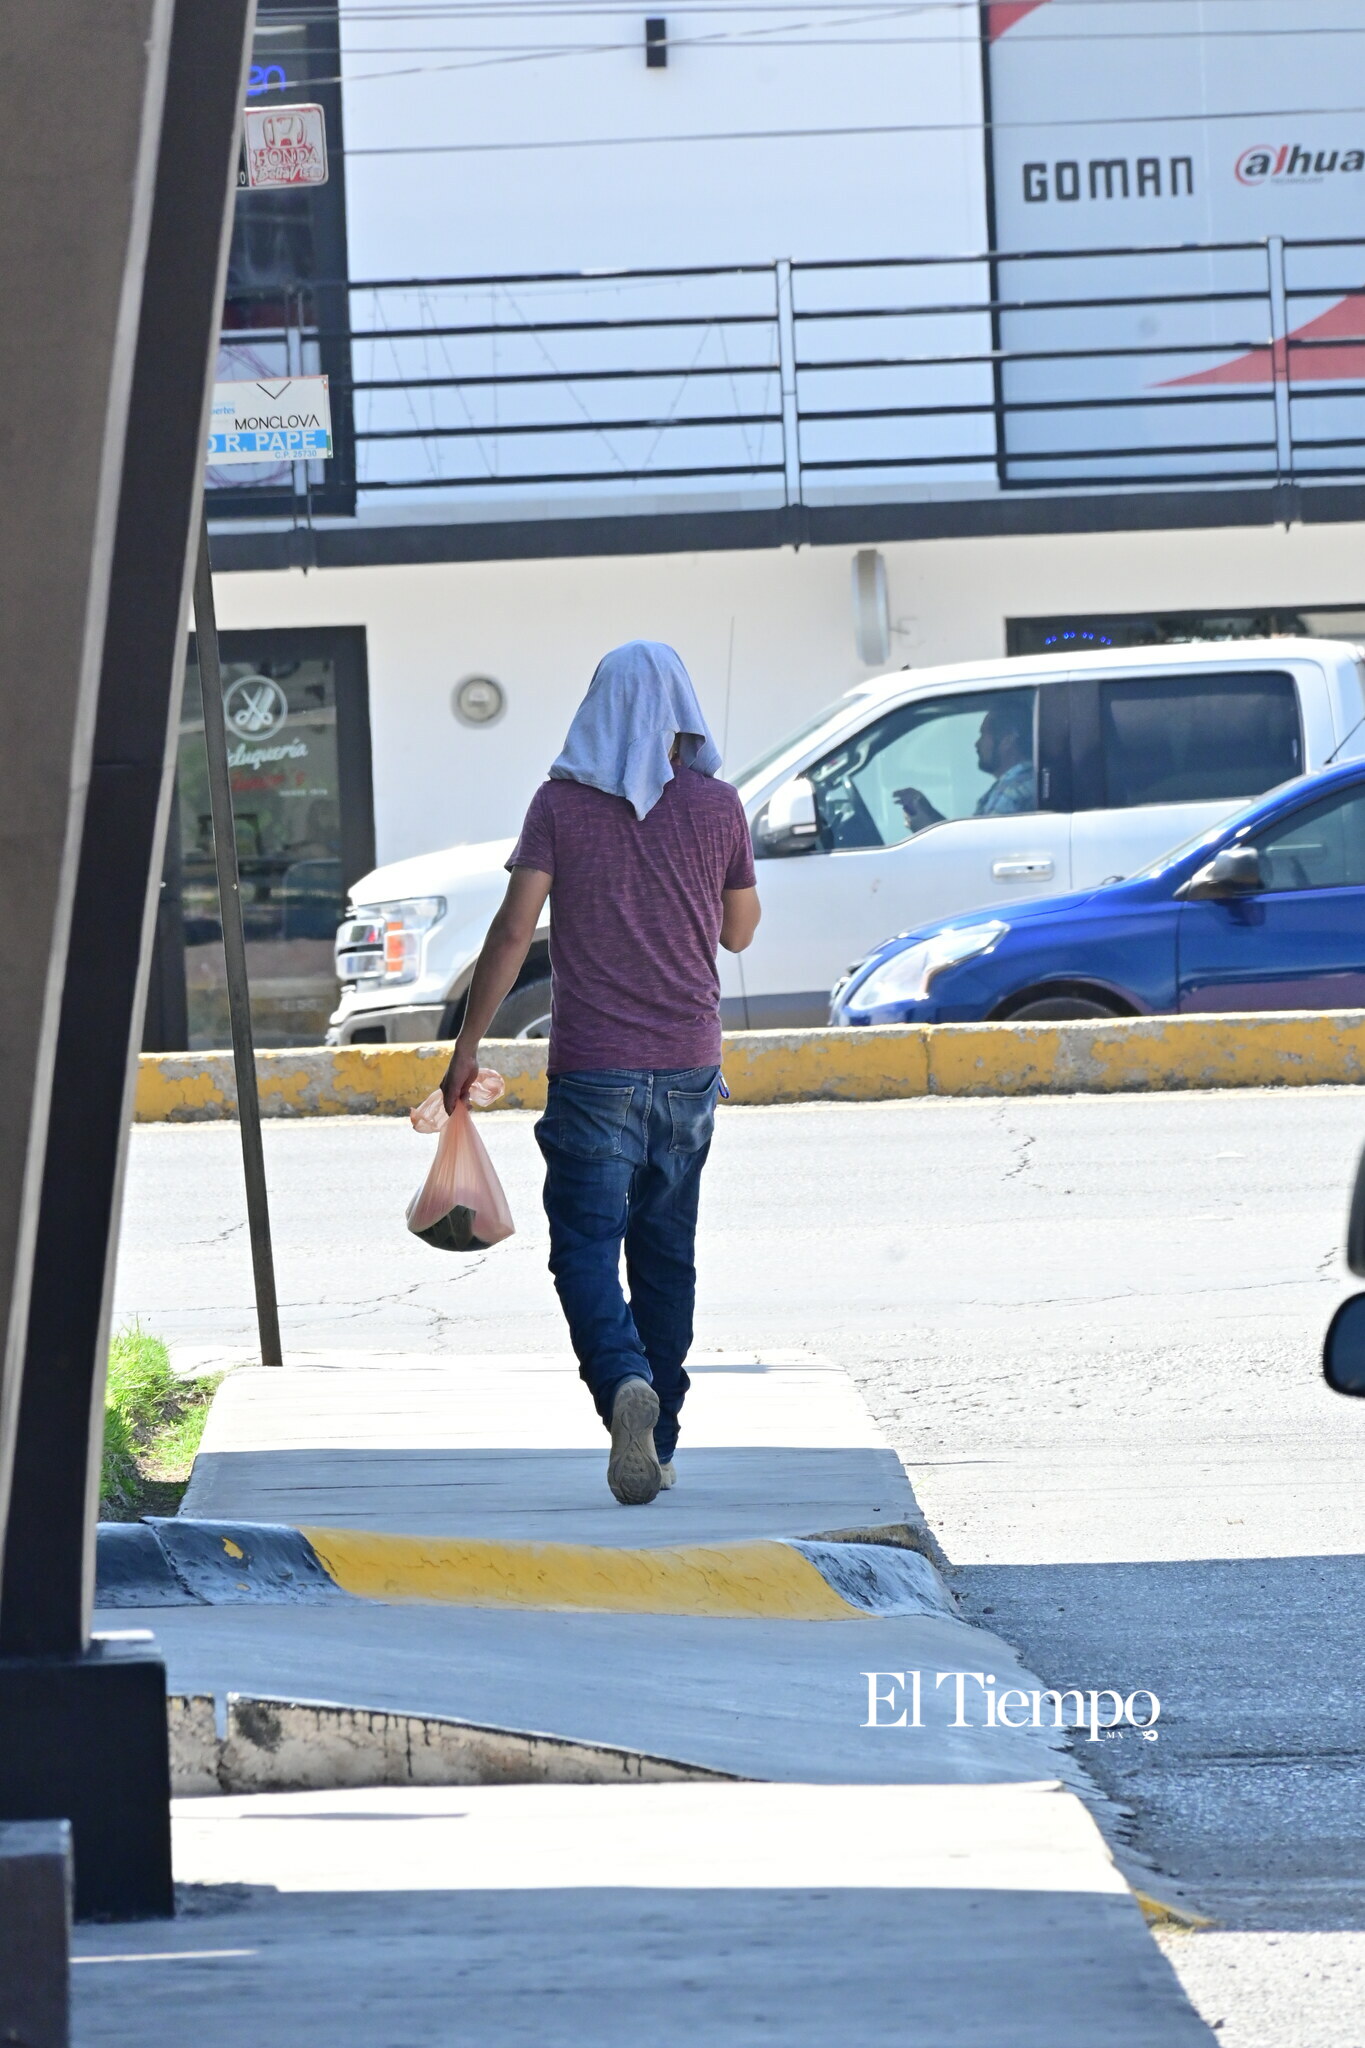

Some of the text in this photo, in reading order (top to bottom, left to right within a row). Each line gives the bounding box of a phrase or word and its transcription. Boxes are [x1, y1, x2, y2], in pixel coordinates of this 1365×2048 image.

[254, 147, 319, 168] HONDA
[234, 414, 320, 431] MONCLOVA
[225, 434, 248, 452] R.
[256, 430, 317, 451] PAPE
